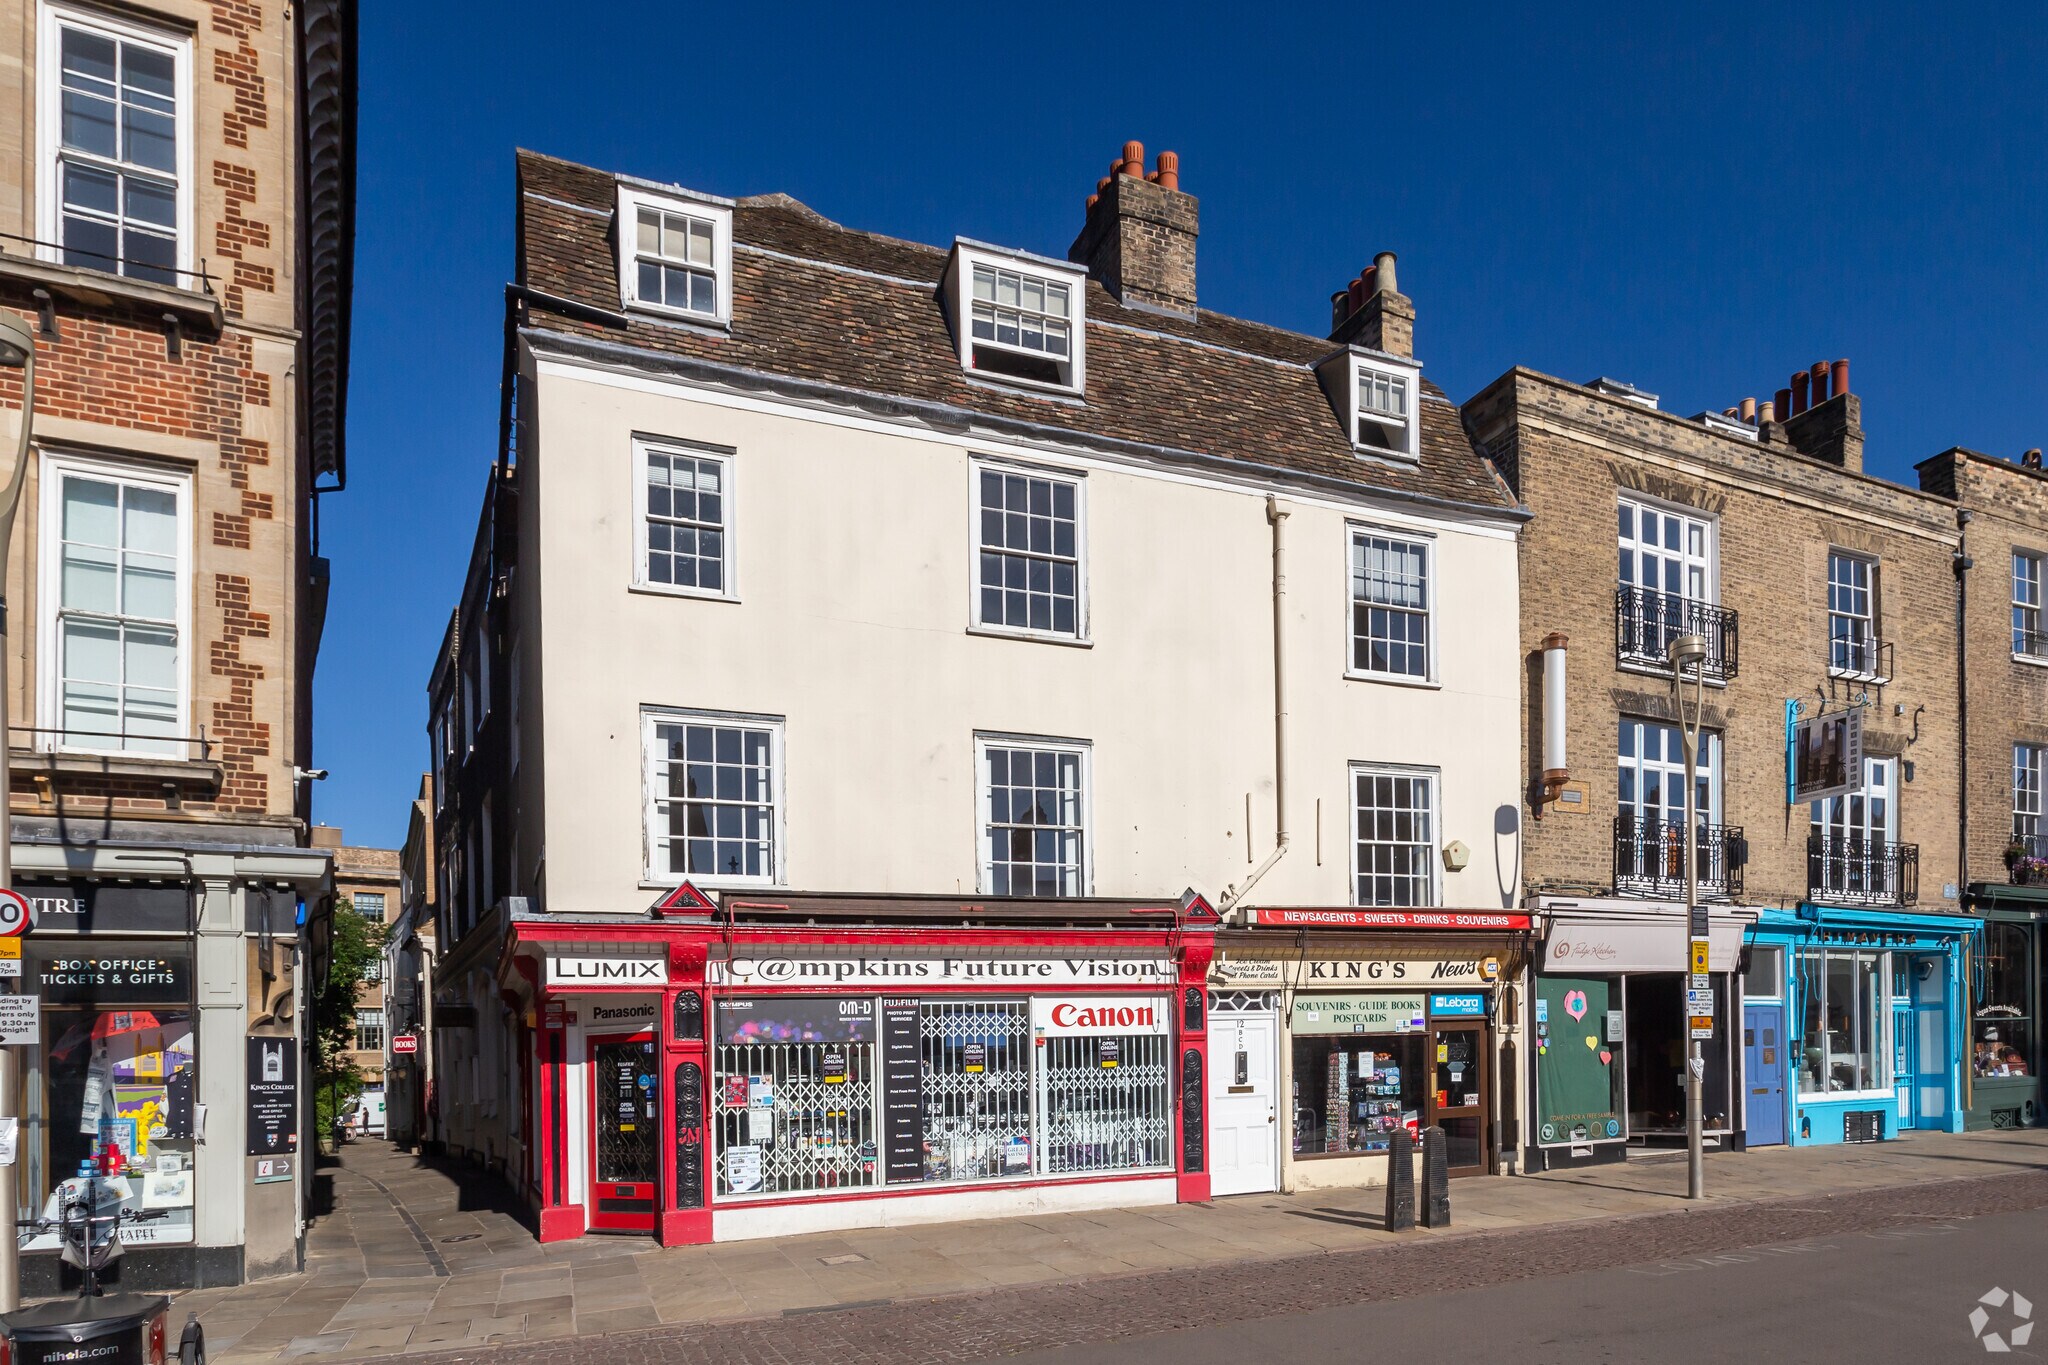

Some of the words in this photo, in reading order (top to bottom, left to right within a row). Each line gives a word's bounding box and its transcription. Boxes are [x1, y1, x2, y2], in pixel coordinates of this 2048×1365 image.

[1284, 911, 1357, 923] NEWSAGENTS
[1364, 912, 1406, 923] SWEETS
[1413, 914, 1449, 924] DRINKS
[1456, 916, 1509, 926] SOUVENIRS
[60, 960, 91, 970] BOX
[100, 960, 156, 970] OFFICE
[556, 957, 660, 978] LUMIX
[725, 956, 929, 982] C@mpkins
[942, 958, 1052, 976] Future
[1063, 958, 1157, 976] Vision
[1256, 964, 1278, 972] Drinks
[1309, 960, 1406, 978] KING'S
[1431, 961, 1477, 979] News
[40, 974, 105, 985] TICKETS
[112, 974, 122, 984] &
[129, 973, 174, 984] GIFTS
[1240, 971, 1259, 979] Phone
[1260, 971, 1278, 979] Cards
[884, 999, 919, 1007] FUJIFILM
[1296, 1002, 1351, 1011] SOUVENIRS
[1359, 1001, 1388, 1010] GUIDE
[1391, 1000, 1421, 1010] BOOKS
[1445, 997, 1478, 1007] Lebara
[593, 1004, 655, 1019] Panasonic
[839, 1001, 871, 1015] OM-D
[1976, 1007, 1989, 1017] Vegan
[1051, 1003, 1153, 1027] Canon
[1333, 1014, 1387, 1023] POSTCARDS
[1236, 1019, 1245, 1028] 12
